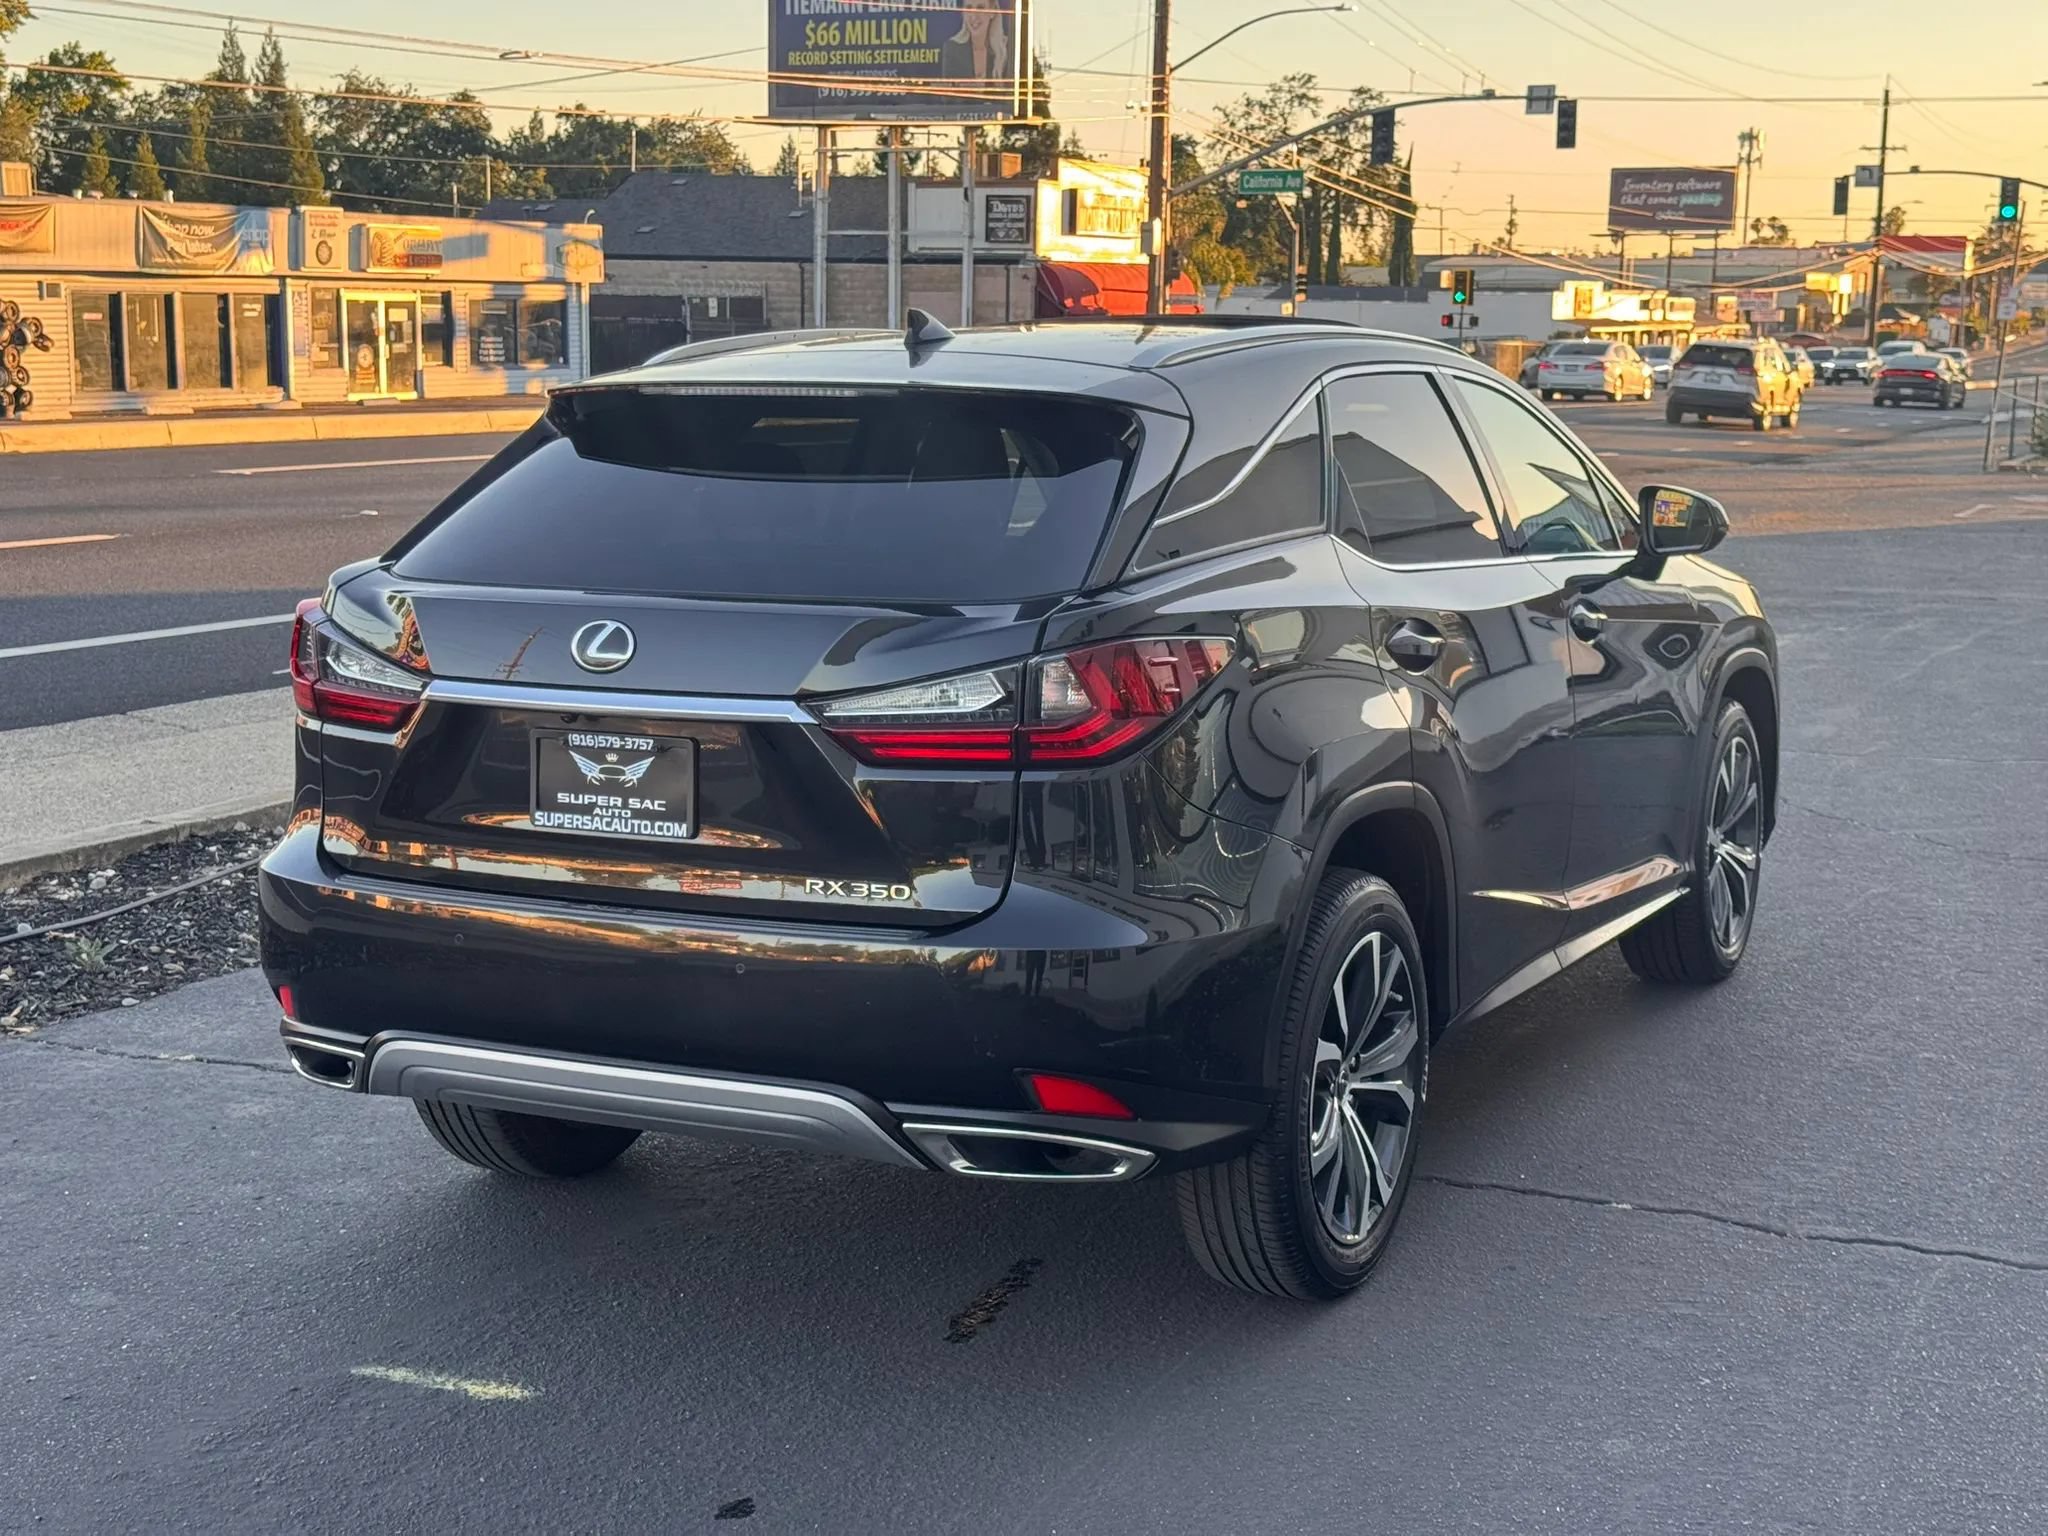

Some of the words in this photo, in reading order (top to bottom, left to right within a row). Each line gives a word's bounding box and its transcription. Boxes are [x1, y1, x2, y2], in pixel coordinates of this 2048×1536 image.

[805, 20, 841, 49] $66
[845, 19, 928, 45] MILLION
[788, 51, 829, 66] RECORD
[830, 50, 873, 65] SETTING
[874, 49, 941, 64] SETTLEMENT
[1243, 175, 1284, 189] California
[1621, 178, 1674, 193] Inventory
[1676, 178, 1722, 192] software
[1621, 194, 1647, 206] that
[568, 733, 654, 750] (916)579-3757
[557, 792, 622, 808] SUPER
[628, 798, 667, 811] SAC
[593, 808, 631, 818] AUTO
[534, 811, 688, 838] SUPERSACAUTO.COM
